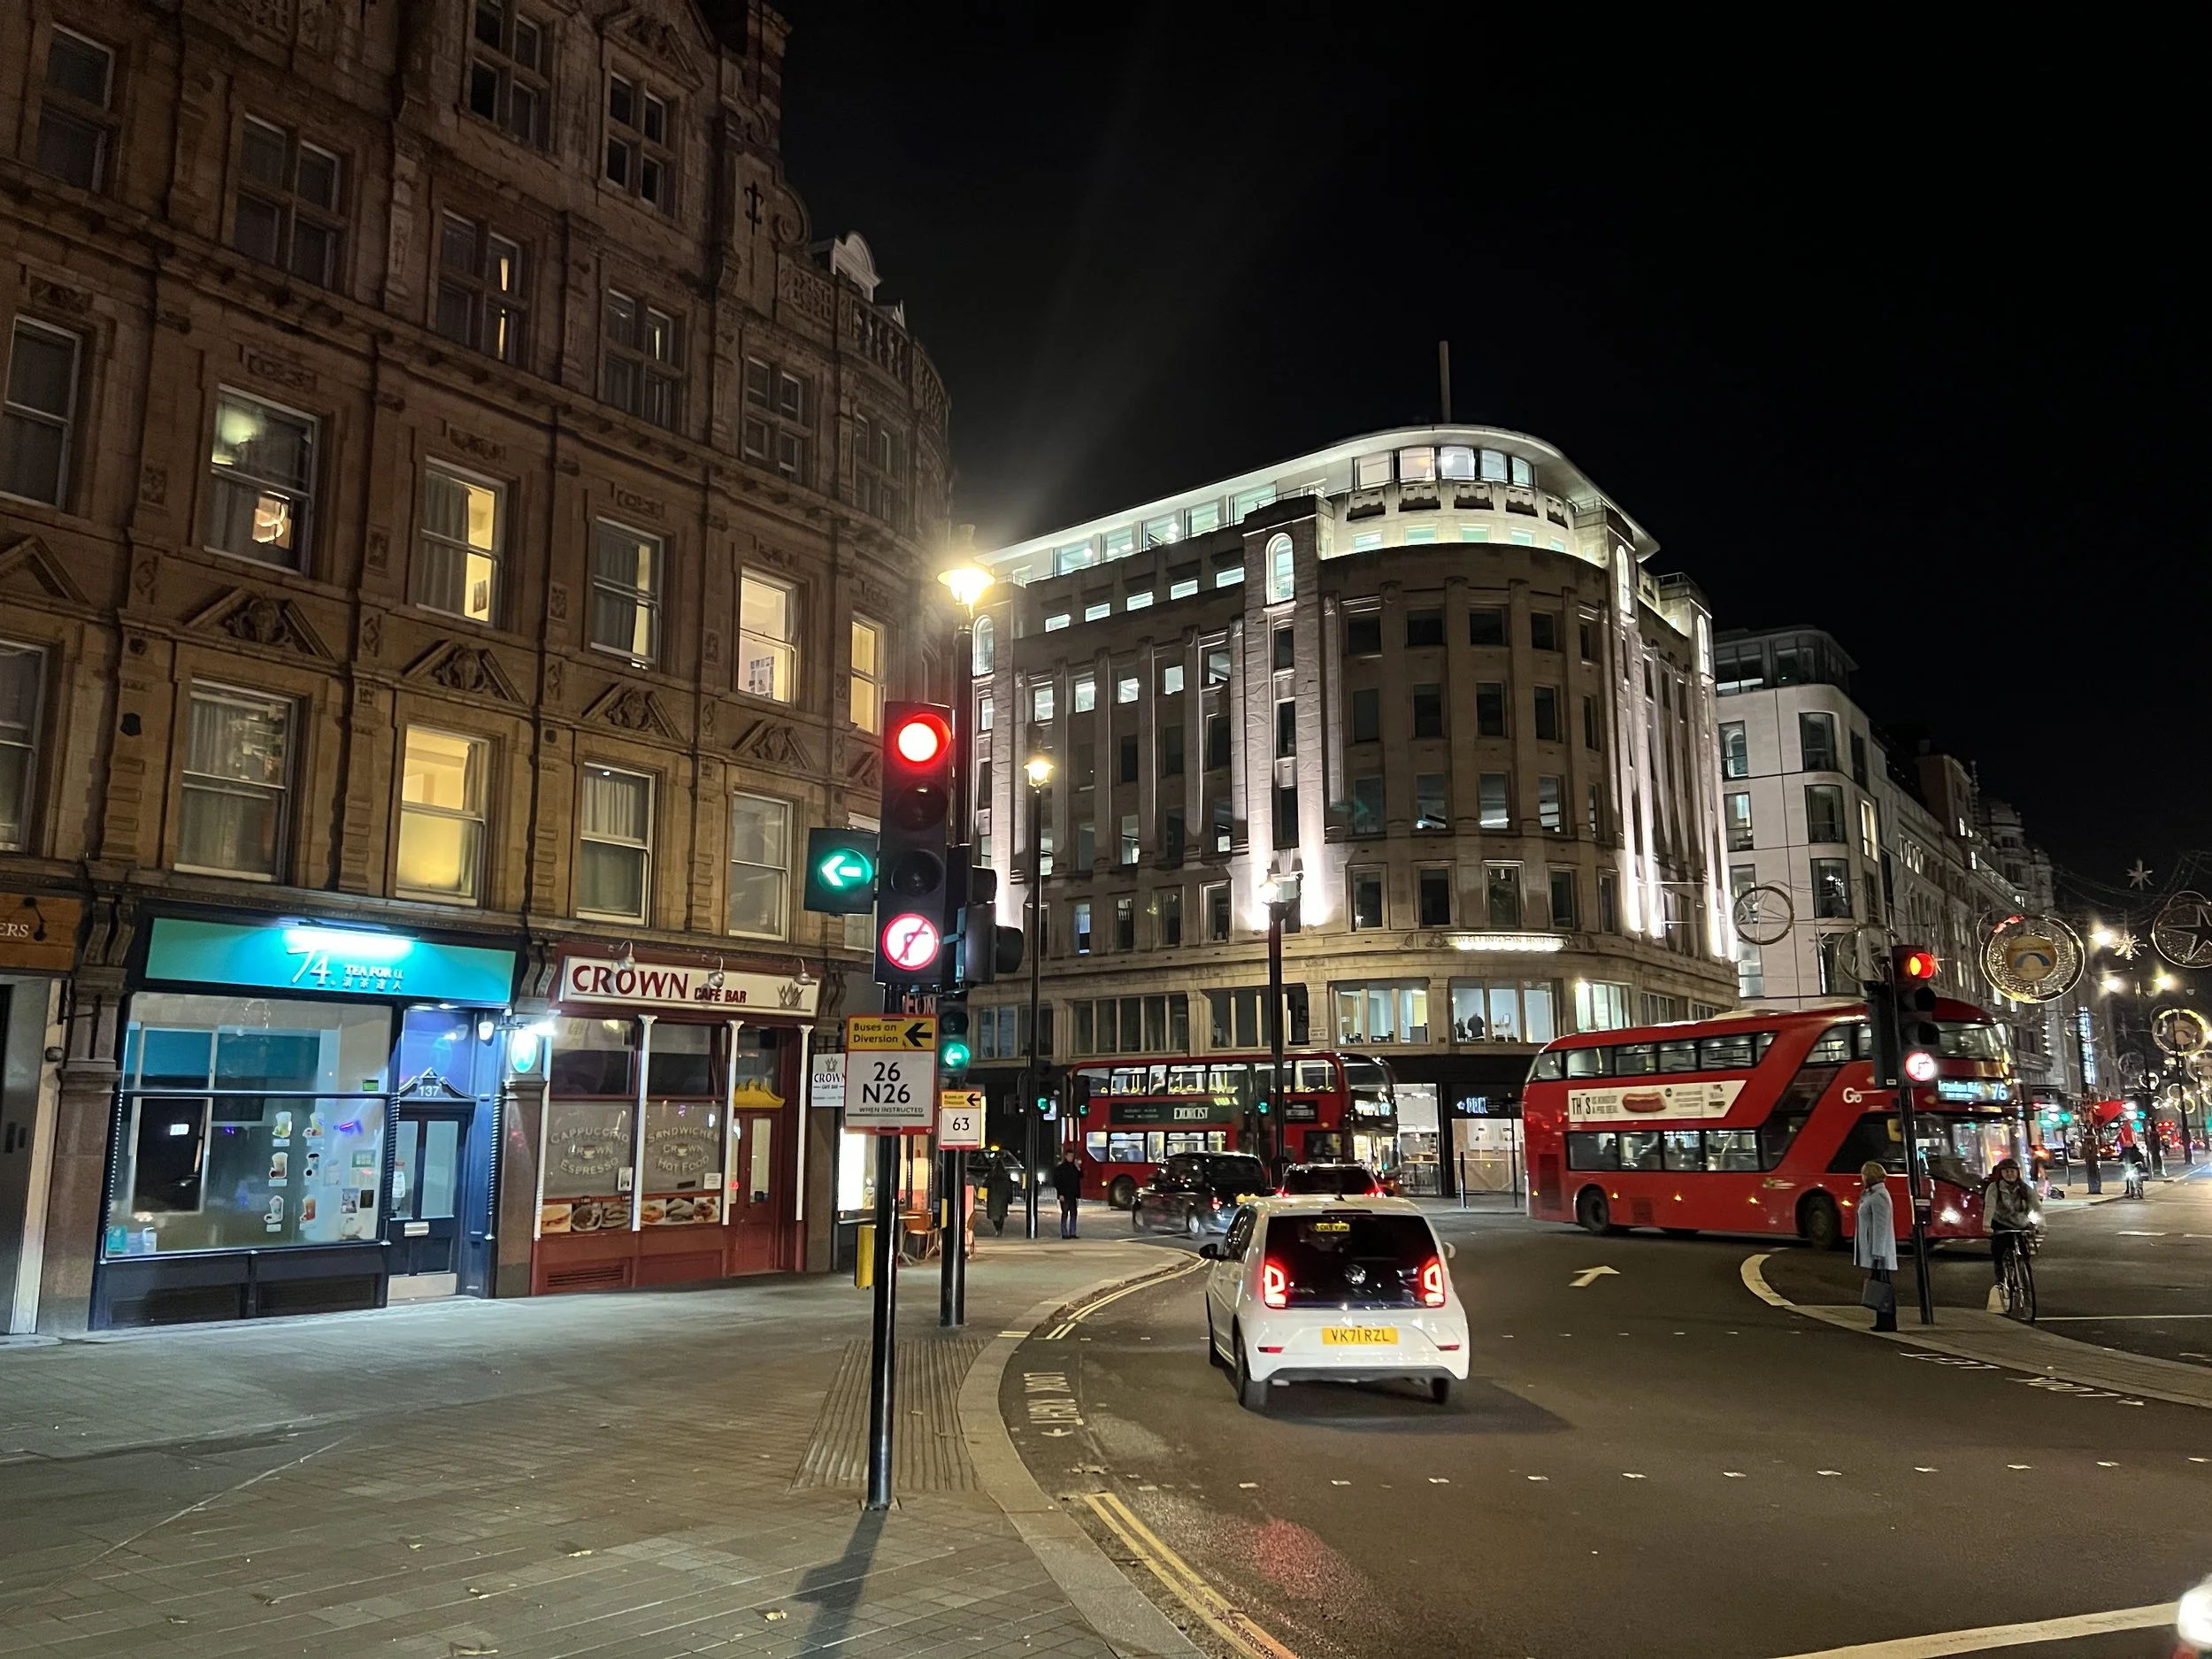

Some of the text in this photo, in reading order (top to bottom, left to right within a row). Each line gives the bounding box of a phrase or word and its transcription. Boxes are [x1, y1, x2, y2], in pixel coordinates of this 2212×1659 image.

[344, 964, 367, 977] TEA
[572, 964, 688, 999] CROWN
[725, 990, 747, 1003] BAR
[854, 1023, 881, 1032] Buses
[853, 1034, 898, 1043] Diversion
[873, 1061, 901, 1082] 26
[419, 1086, 440, 1097] 137
[862, 1083, 910, 1103] N26
[1991, 1083, 2008, 1101] 76
[952, 1118, 970, 1131] 63
[550, 1126, 629, 1144] CAPPUCCINO
[648, 1125, 718, 1142] SANDWICHES
[560, 1157, 618, 1175] ESPRESSO
[1331, 1329, 1390, 1342] VK71 RZL
